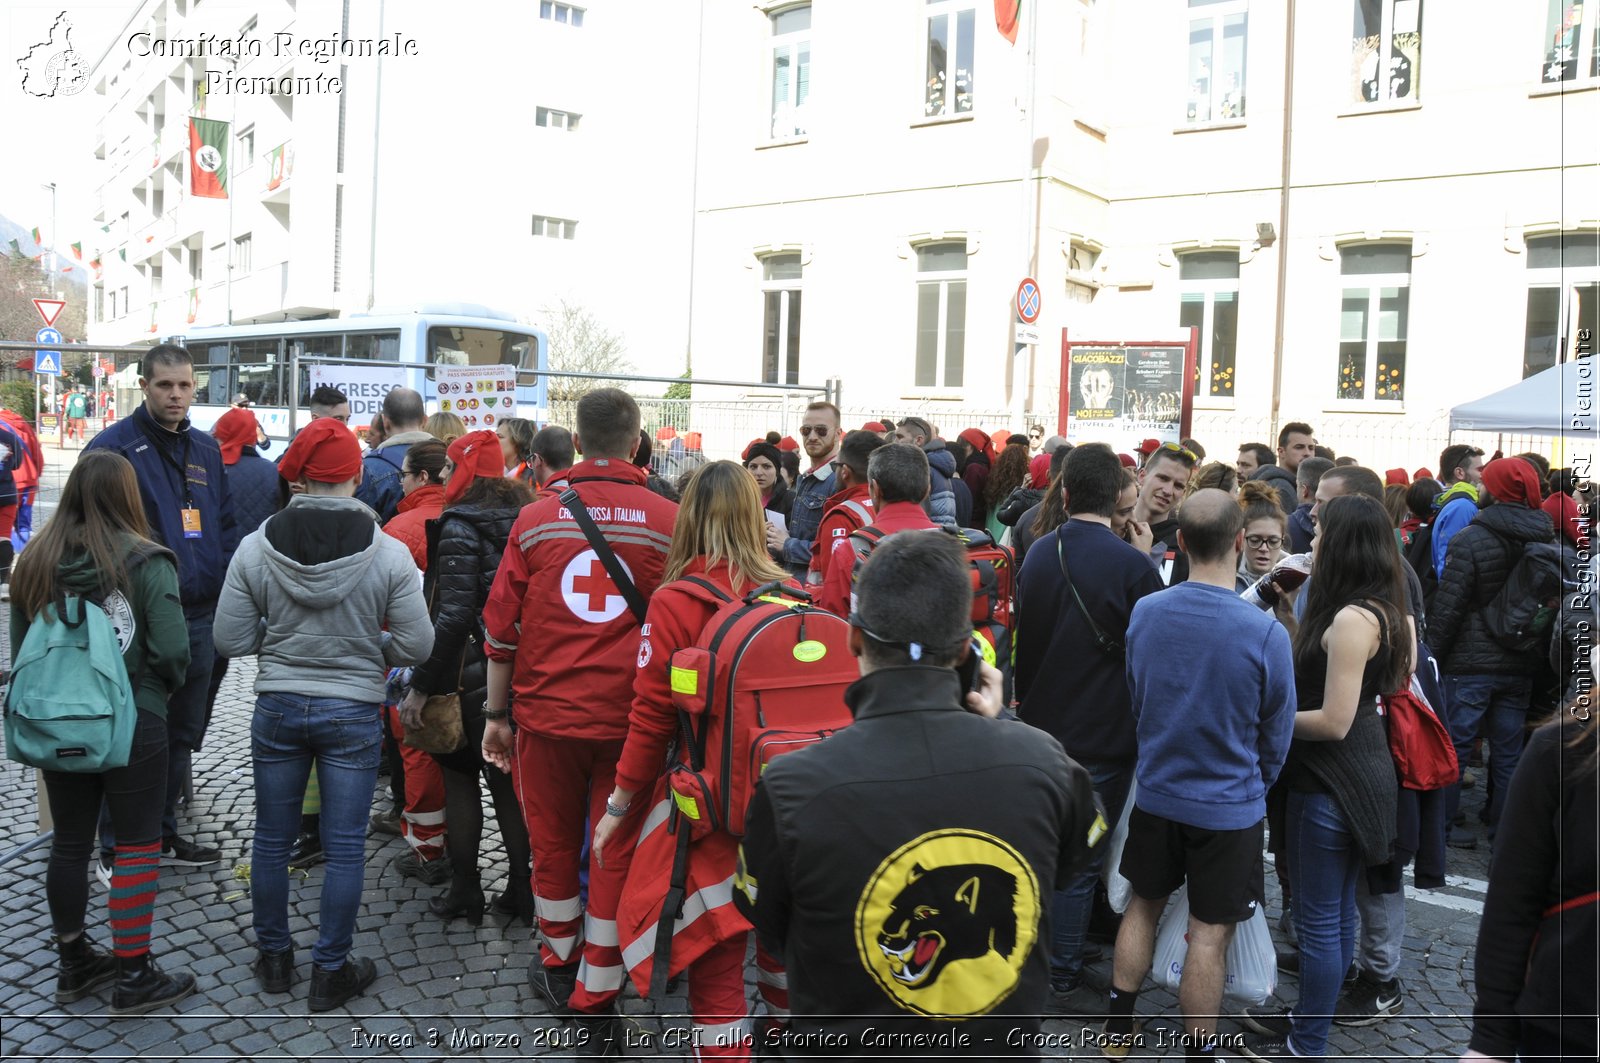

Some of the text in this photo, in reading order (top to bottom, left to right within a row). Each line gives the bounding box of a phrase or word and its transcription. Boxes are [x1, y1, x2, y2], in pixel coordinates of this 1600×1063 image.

[1072, 354, 1125, 364] GIACOBAZZI
[1076, 409, 1092, 418] NOI
[614, 507, 646, 523] ITALIANA
